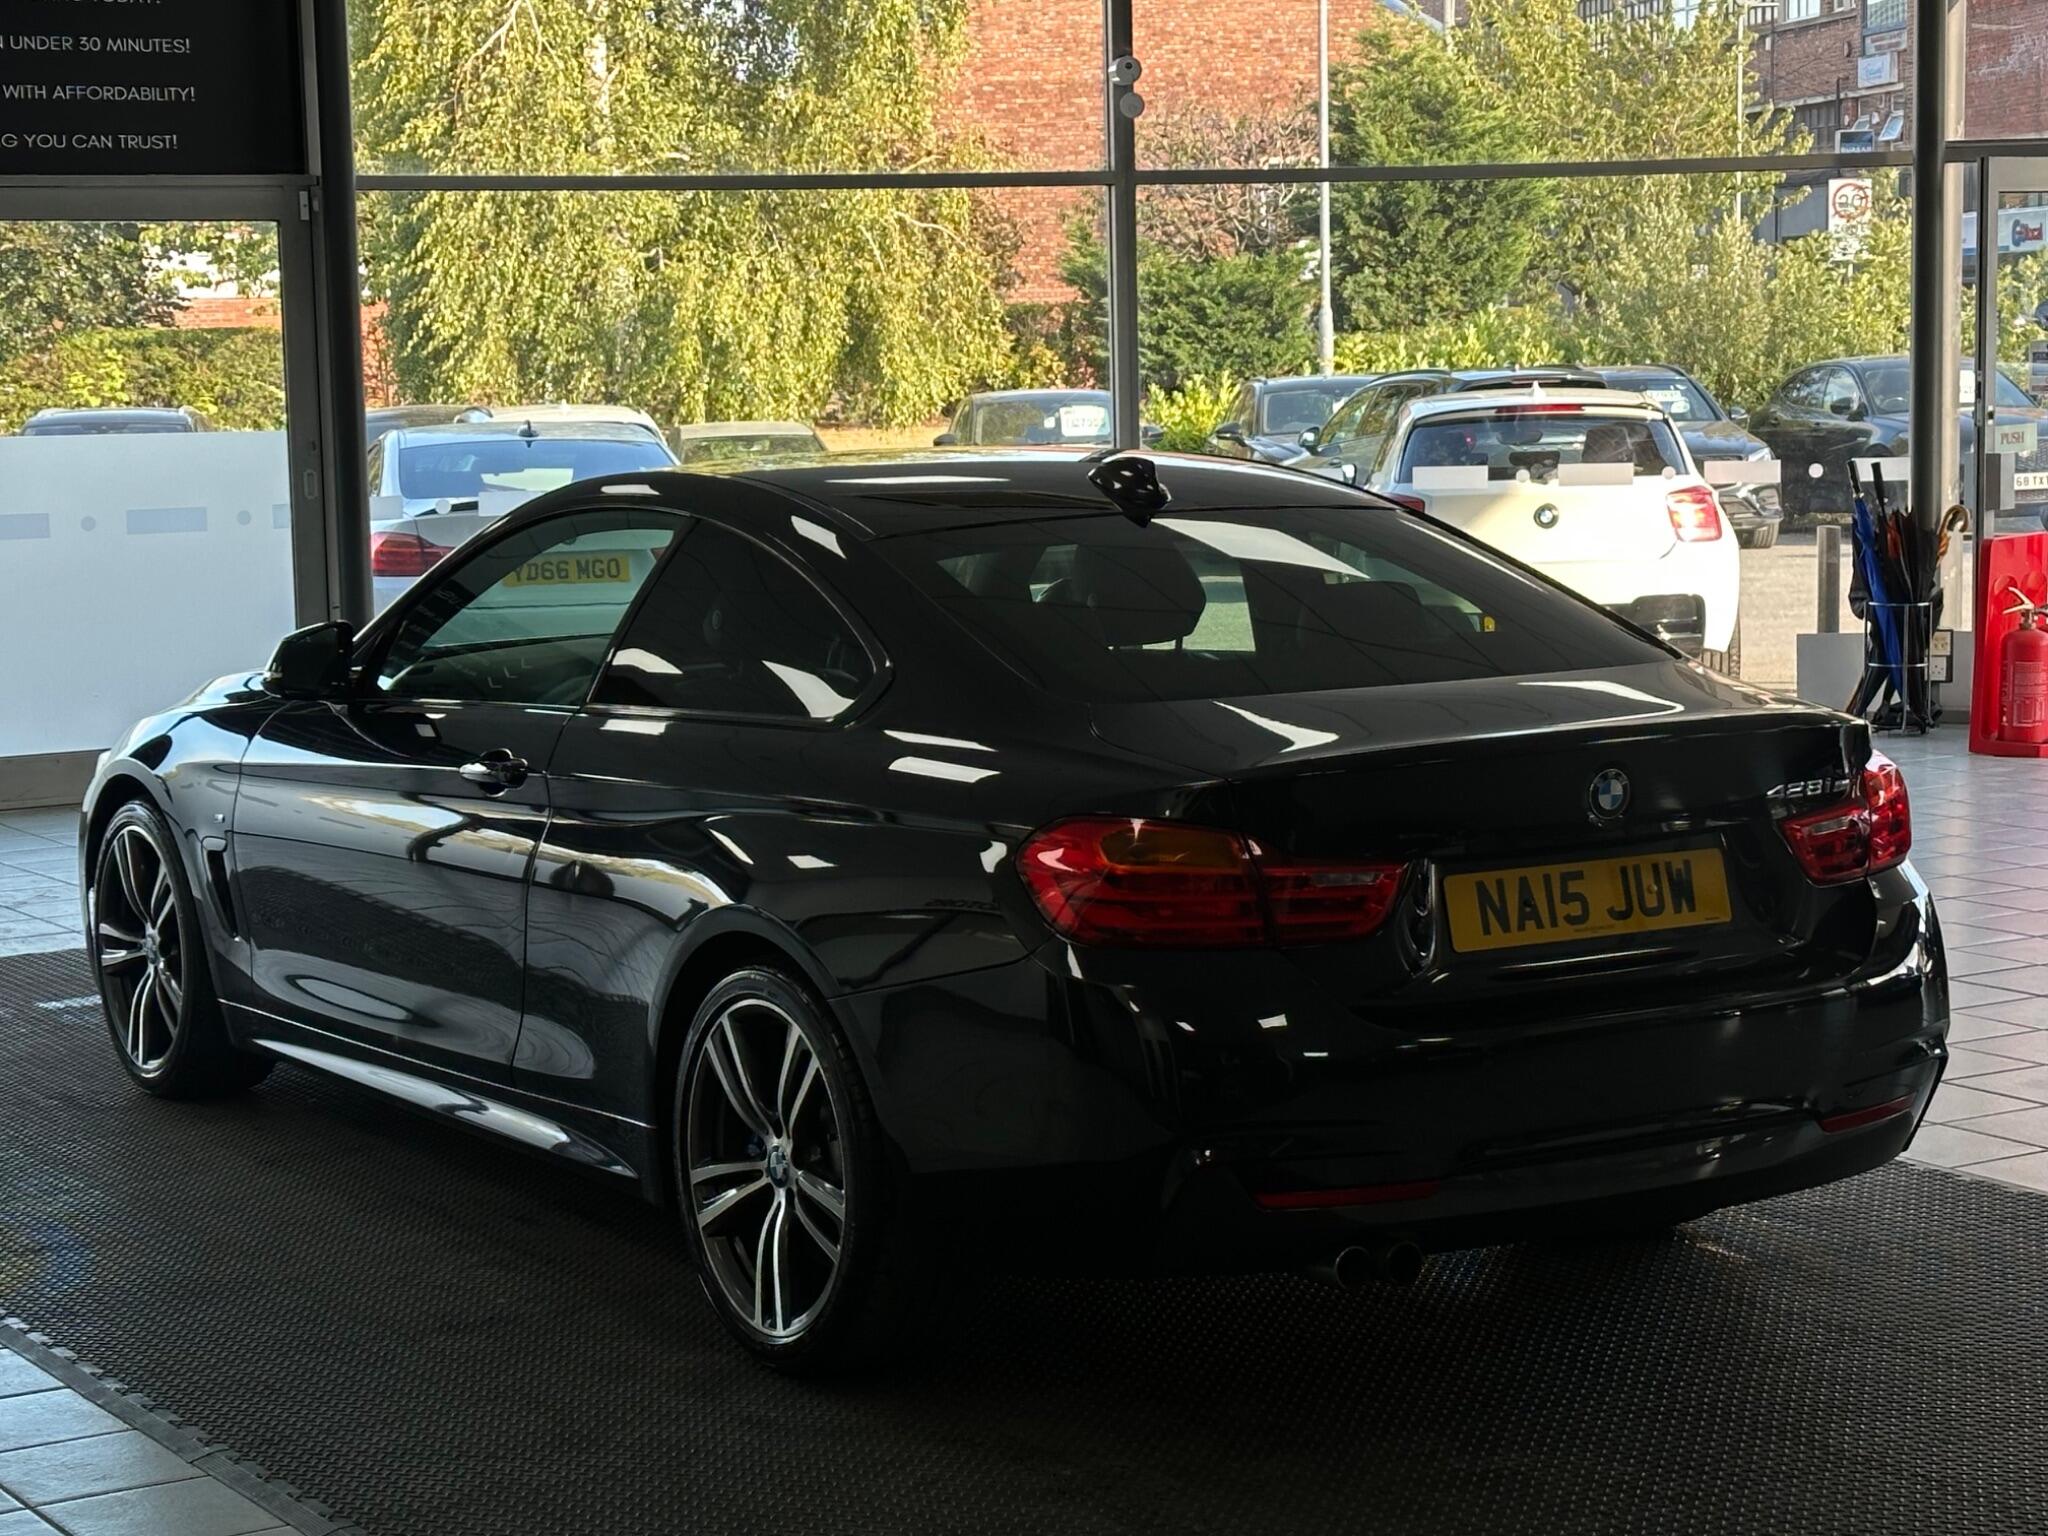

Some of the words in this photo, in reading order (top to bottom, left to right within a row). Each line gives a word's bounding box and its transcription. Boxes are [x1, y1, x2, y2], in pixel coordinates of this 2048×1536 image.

[10, 35, 73, 50] UNDER
[79, 36, 101, 51] 30
[106, 37, 191, 54] MINUTES!
[2, 84, 47, 100] WITH
[52, 85, 196, 102] AFFORDABILITY!
[23, 134, 67, 148] YOU
[72, 134, 113, 149] CAN
[118, 134, 178, 150] TRUST!
[2000, 431, 2025, 445] PUSH
[514, 561, 569, 582] YD66
[576, 558, 621, 579] MGO
[1475, 870, 1590, 936] NA15
[1606, 859, 1696, 921] JUW
